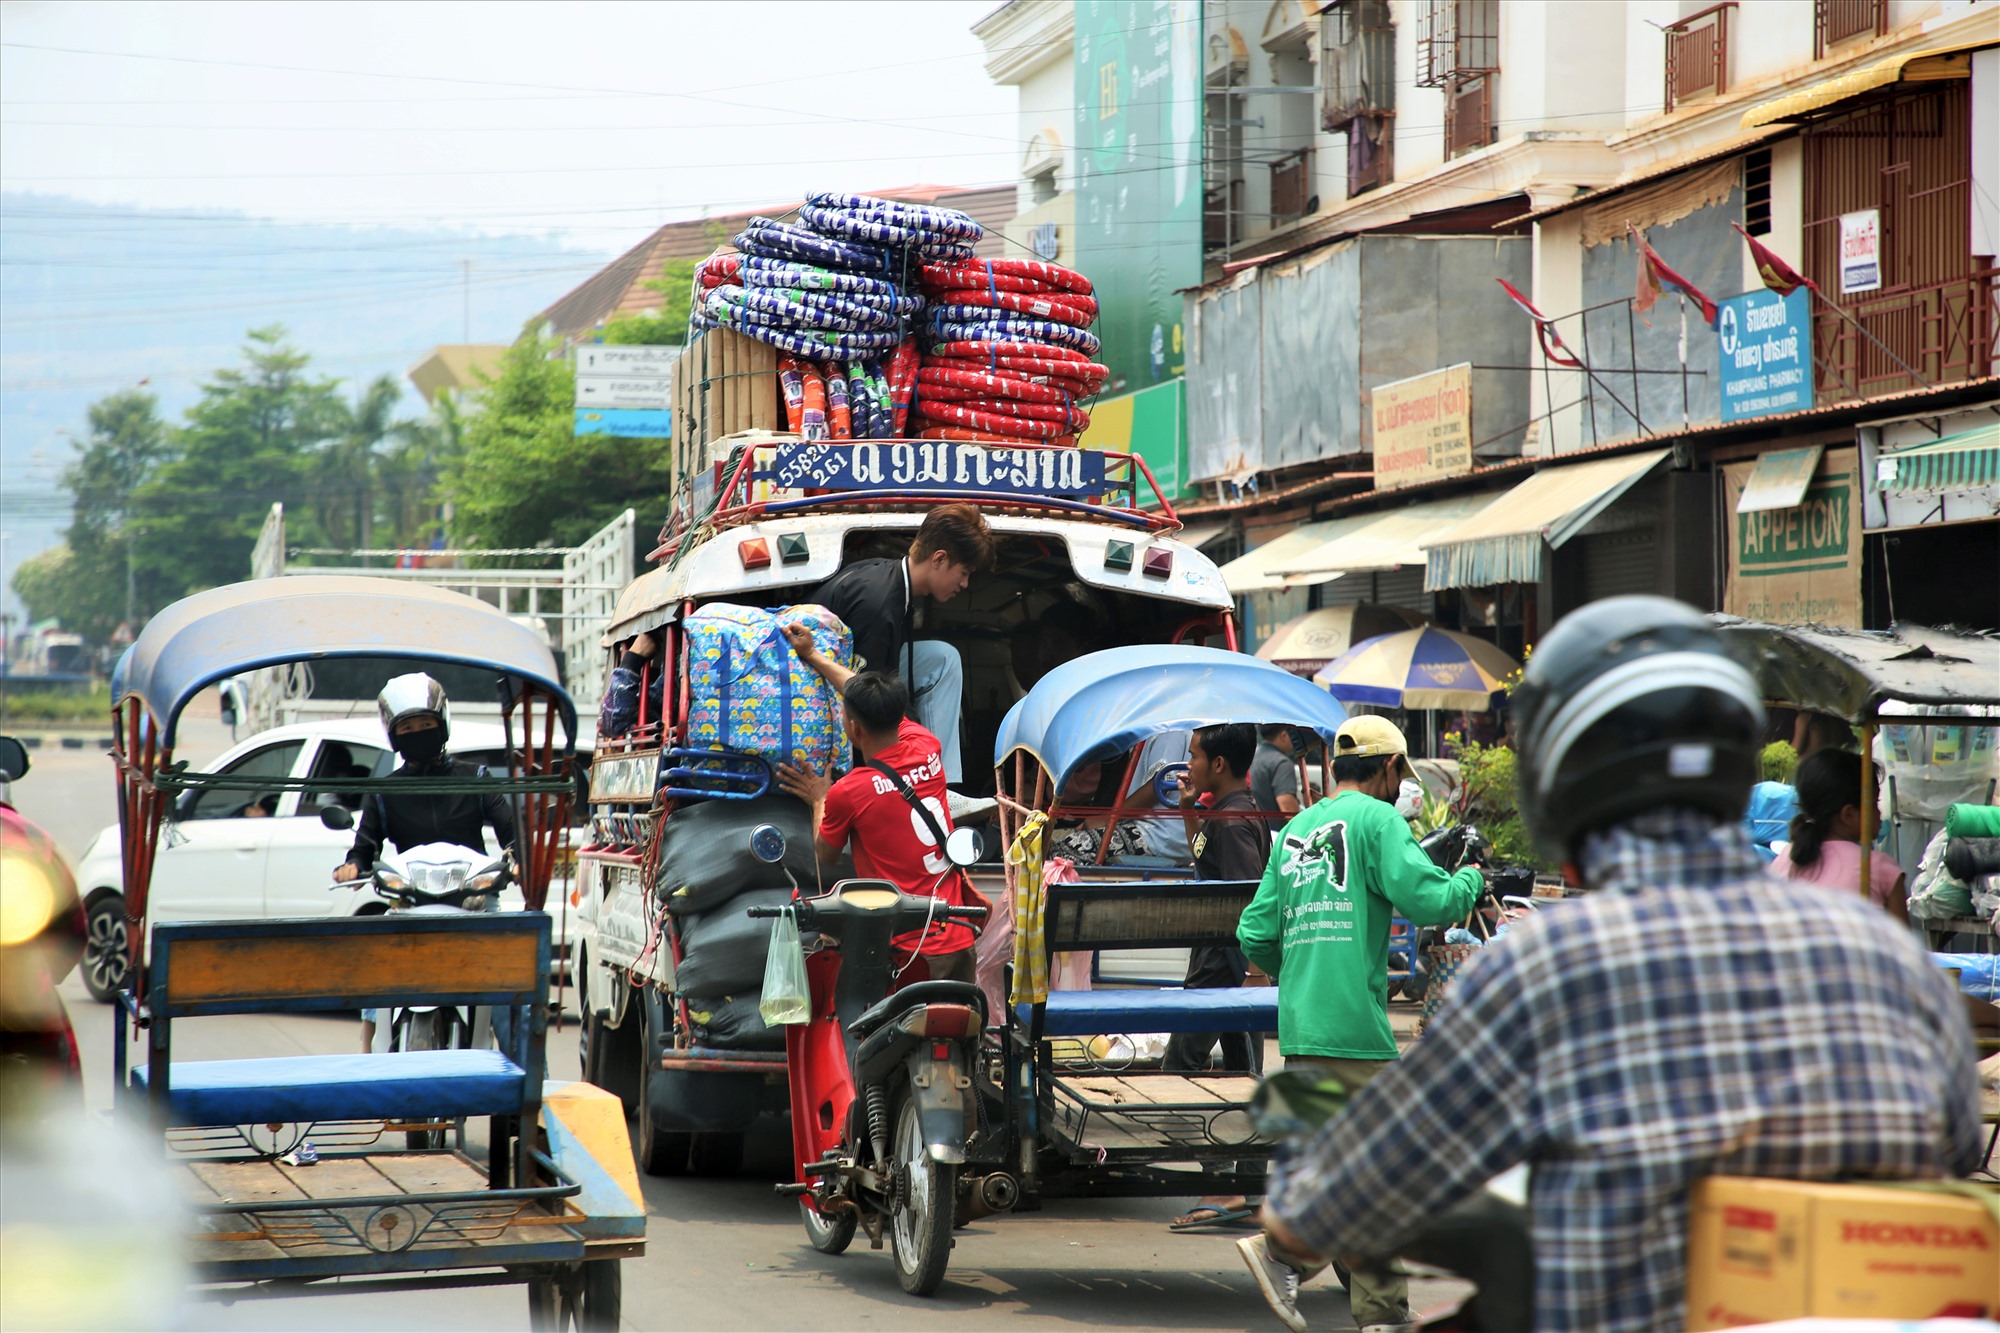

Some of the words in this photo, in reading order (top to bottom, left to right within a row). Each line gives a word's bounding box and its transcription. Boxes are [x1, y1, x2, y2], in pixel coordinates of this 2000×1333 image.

[1768, 367, 1804, 389] PHARMACY
[811, 451, 849, 487] 261
[1744, 496, 1842, 555] APPETON
[909, 765, 930, 785] FC
[1840, 1219, 1991, 1251] HONDA
